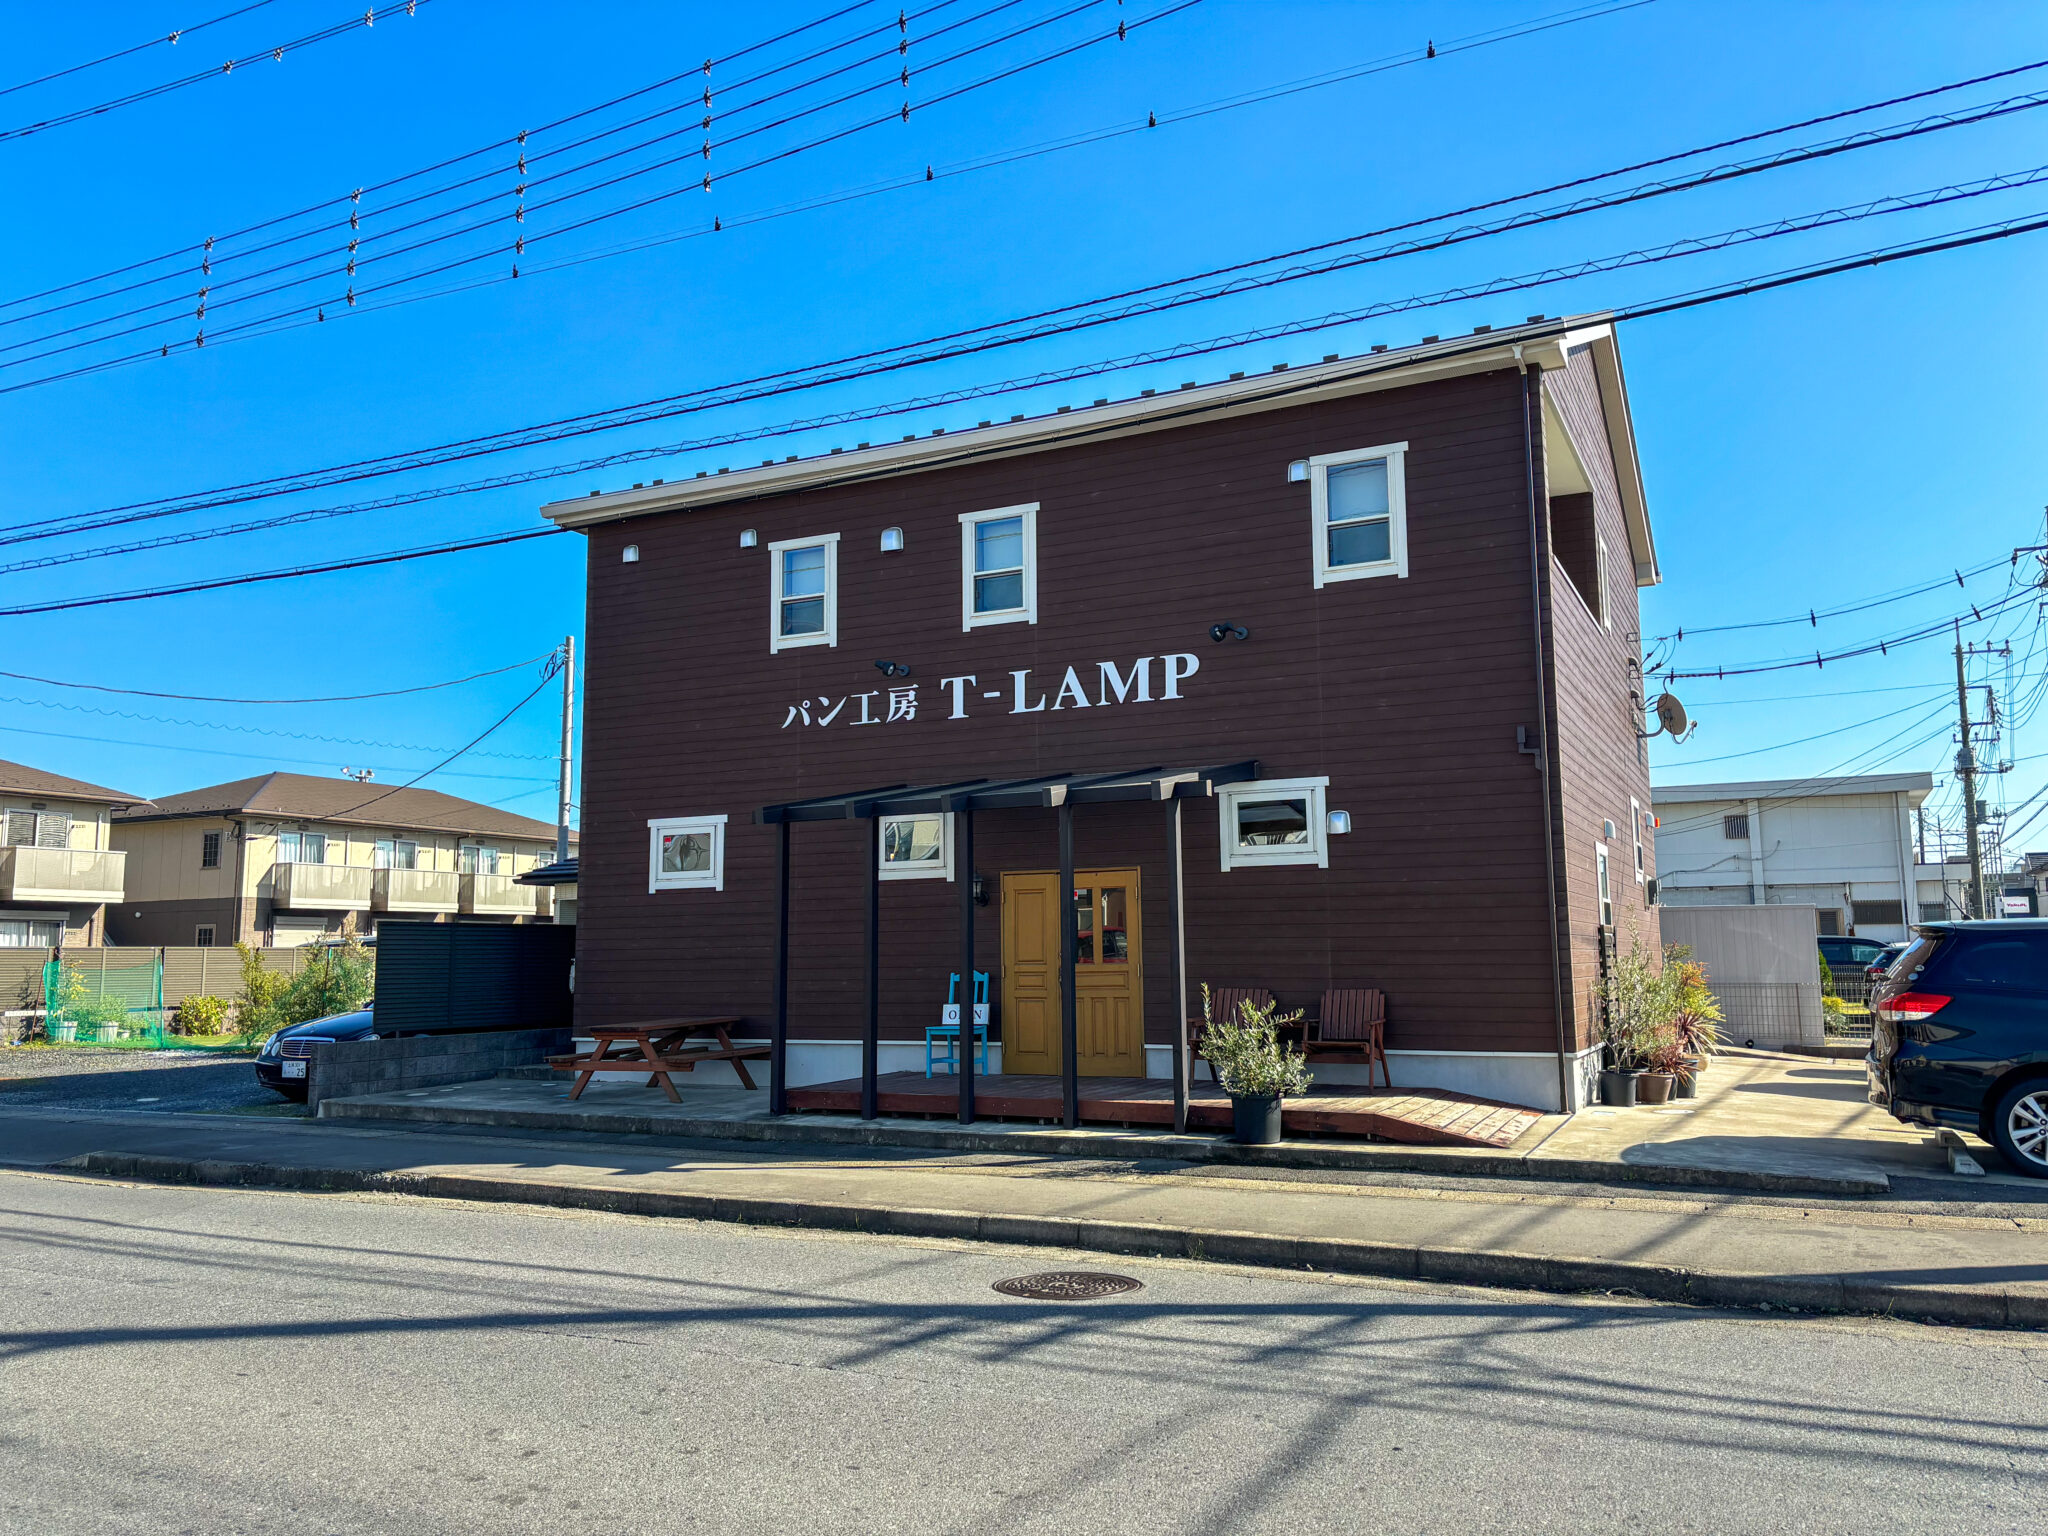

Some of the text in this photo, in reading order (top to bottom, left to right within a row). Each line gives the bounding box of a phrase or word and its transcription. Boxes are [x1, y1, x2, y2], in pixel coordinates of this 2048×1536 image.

[781, 653, 1200, 729] パン工房 T-LAMP
[948, 1010, 982, 1020] ON
